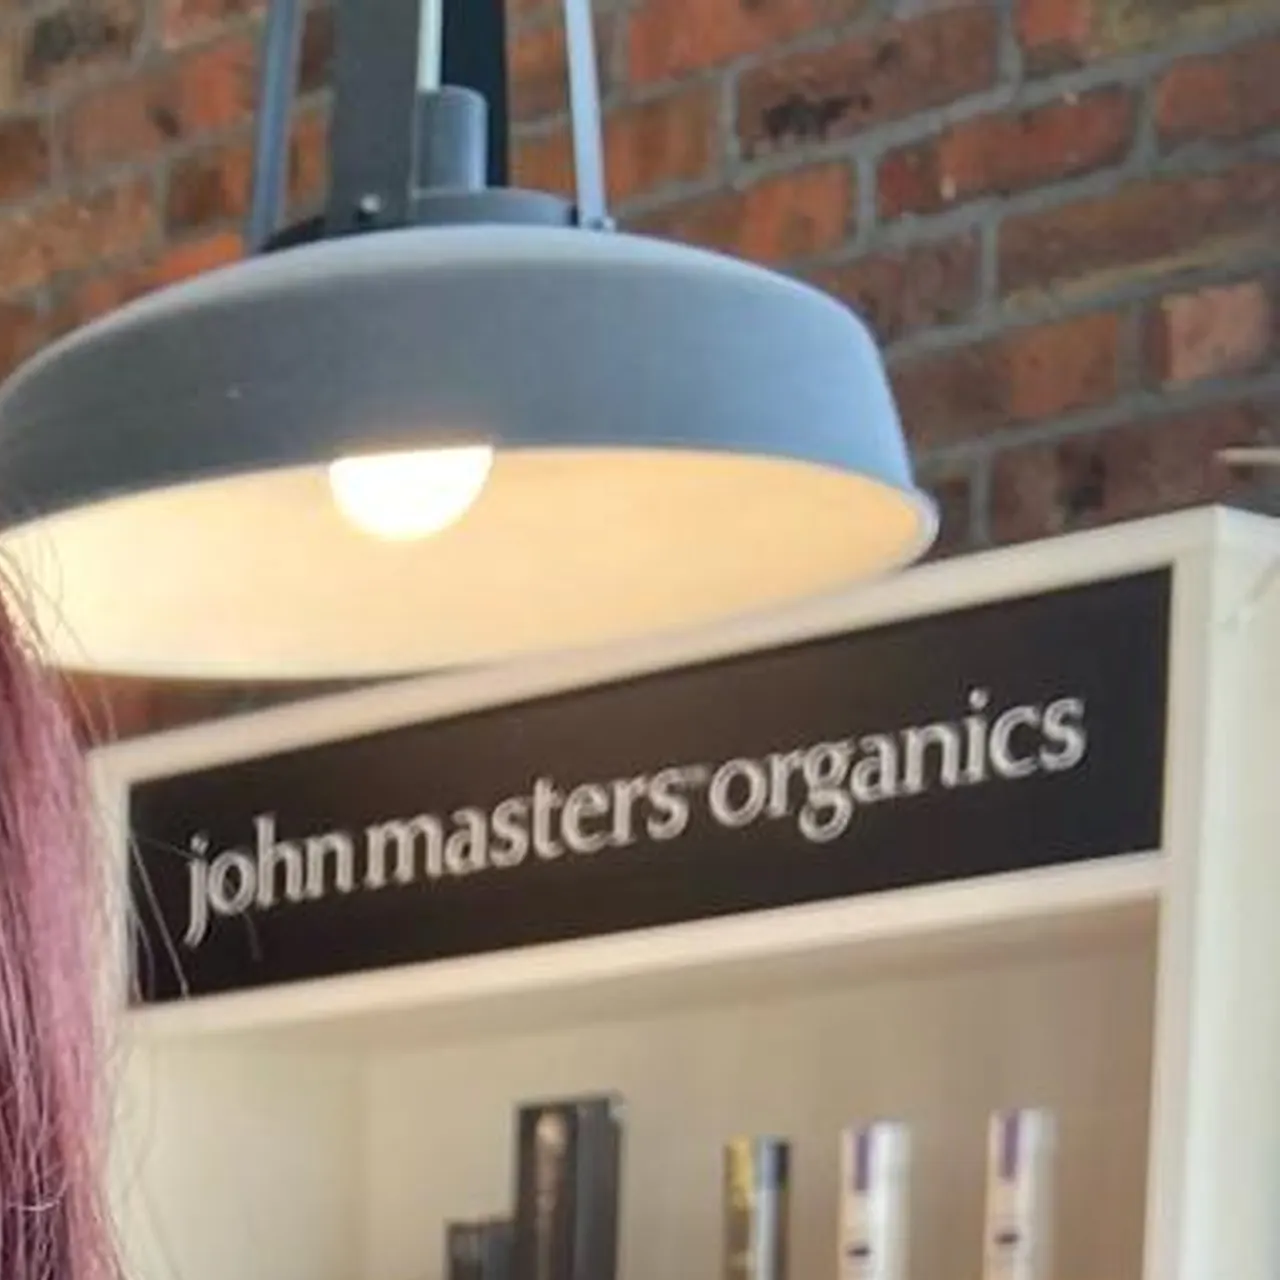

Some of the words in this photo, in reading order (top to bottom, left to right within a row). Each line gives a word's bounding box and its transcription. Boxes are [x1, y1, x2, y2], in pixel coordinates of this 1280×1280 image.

[183, 812, 355, 947] john
[364, 766, 689, 890] masters
[708, 687, 1088, 843] organics
